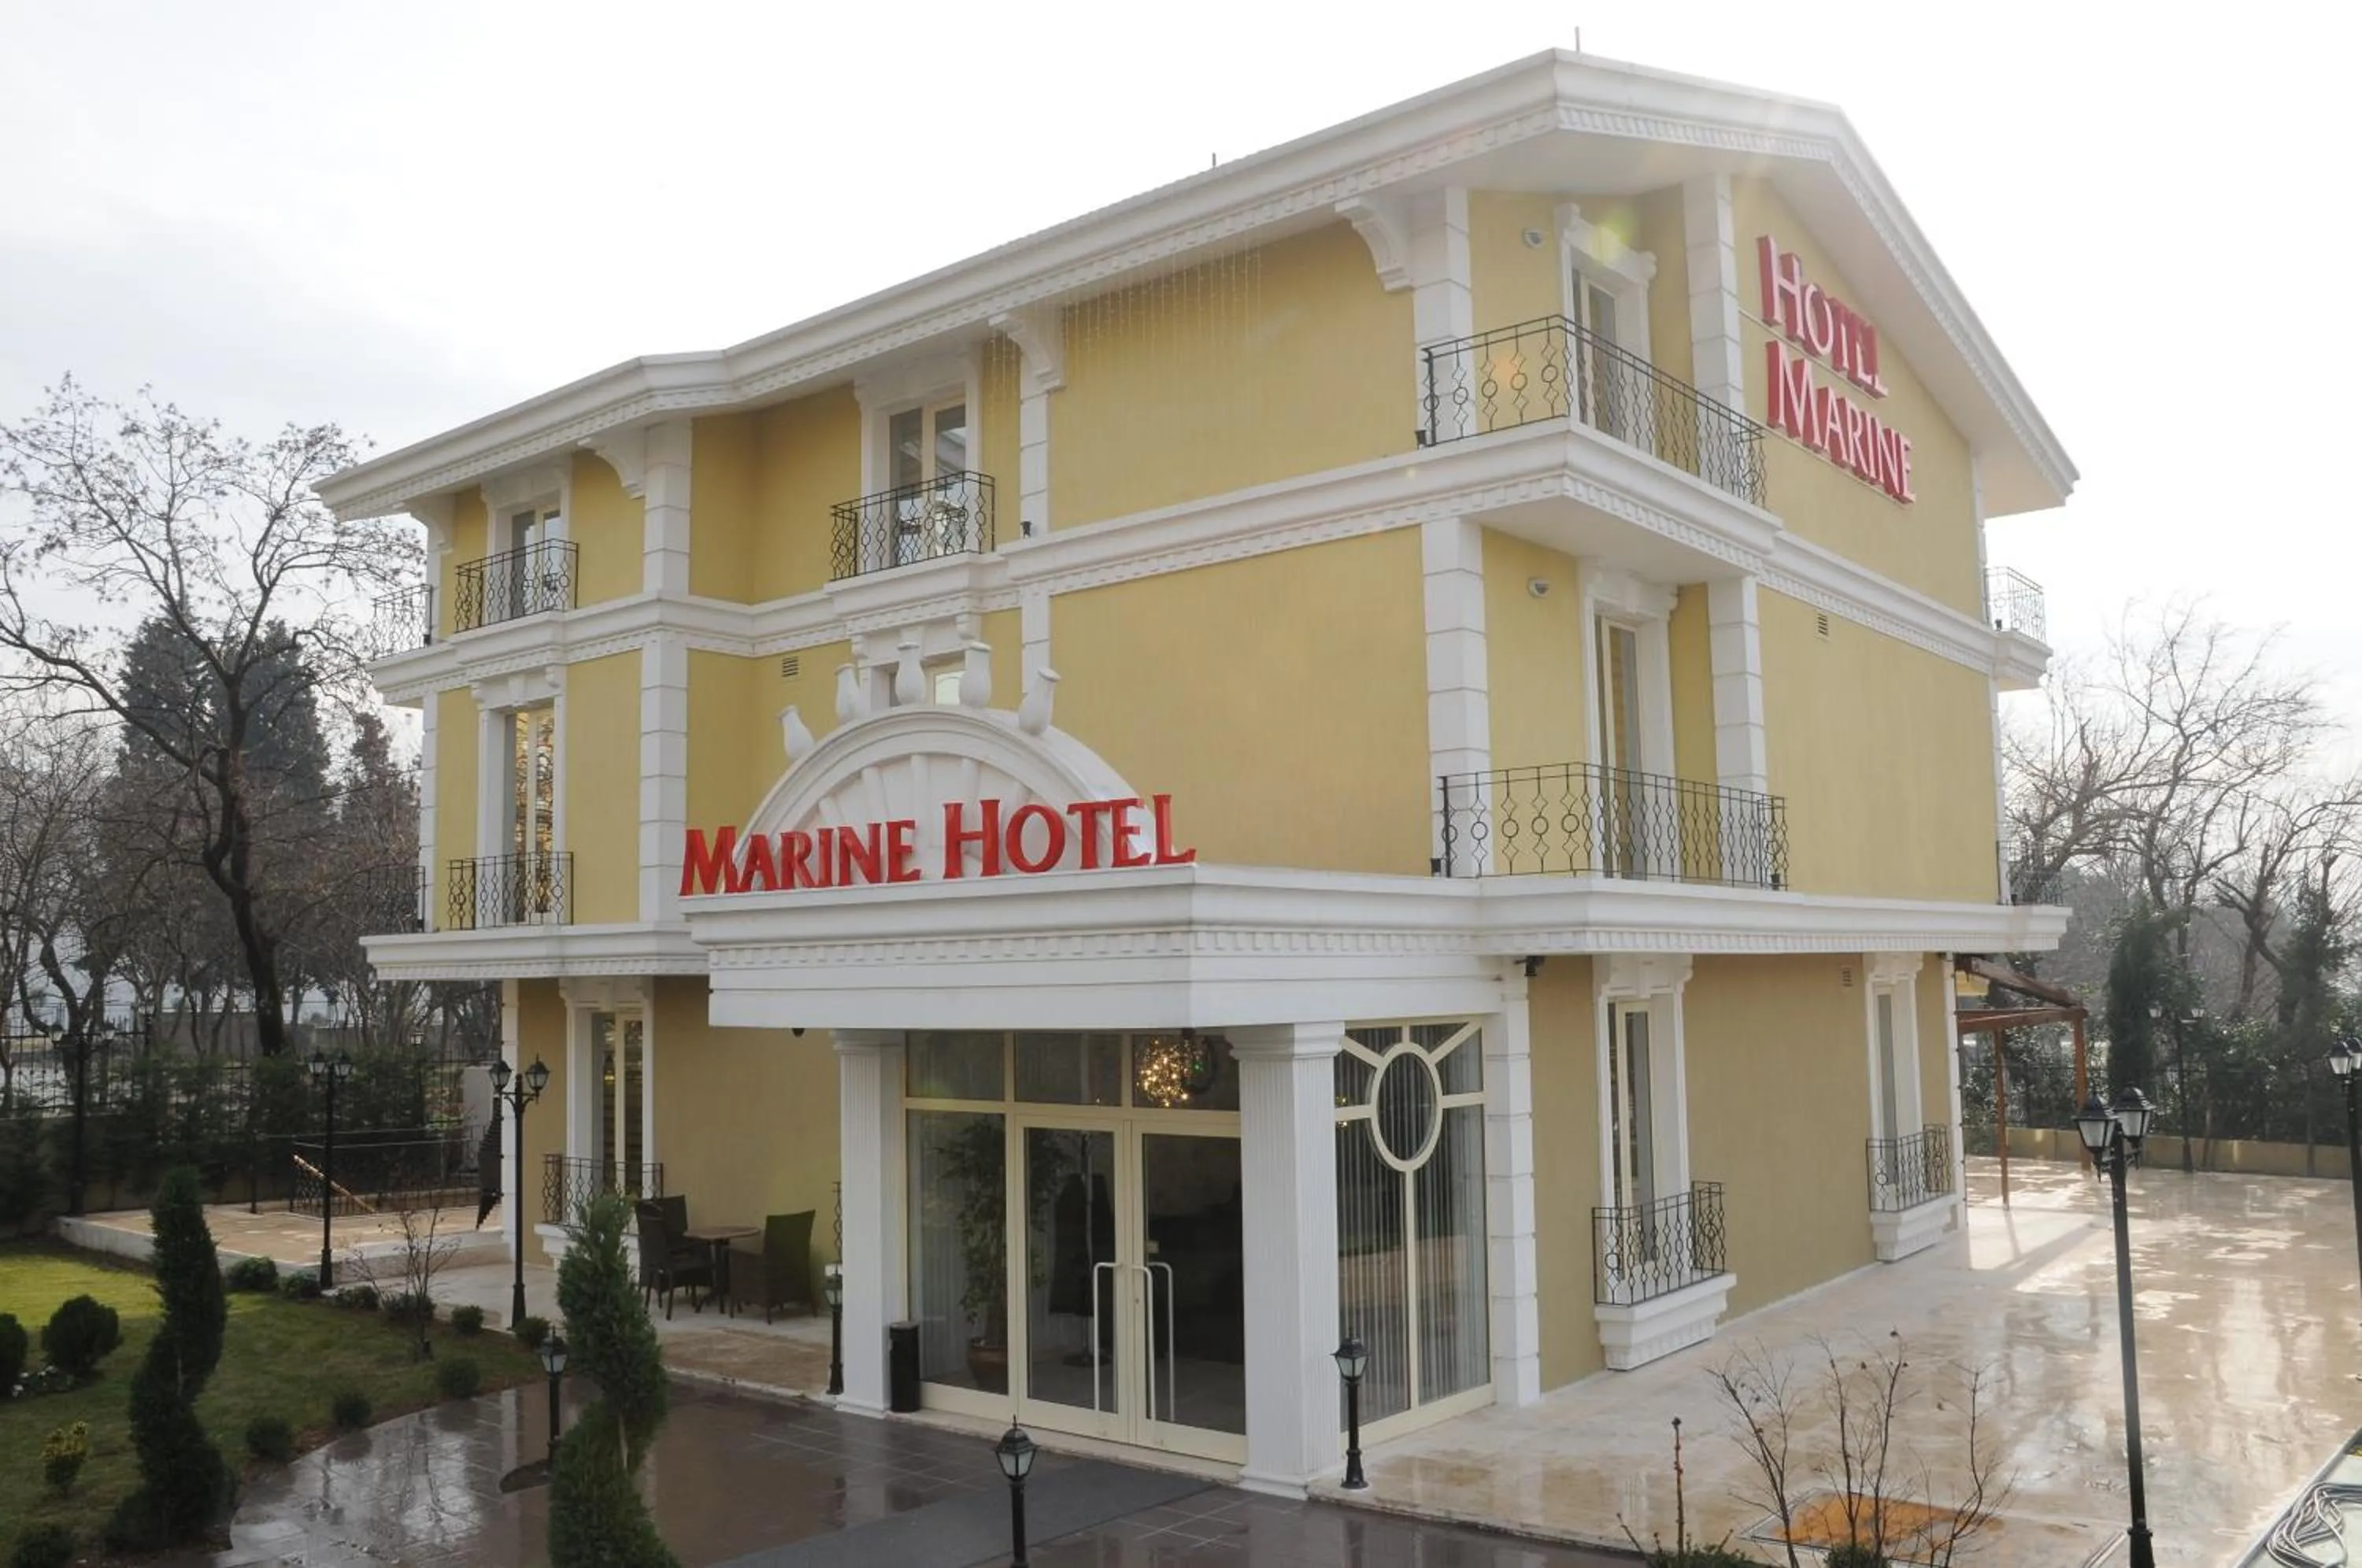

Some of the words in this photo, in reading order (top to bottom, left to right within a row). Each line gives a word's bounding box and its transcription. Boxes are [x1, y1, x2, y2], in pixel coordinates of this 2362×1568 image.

[1766, 340, 1916, 505] MARINE
[679, 819, 921, 897] MARINE
[943, 793, 1197, 879] HOTEL
